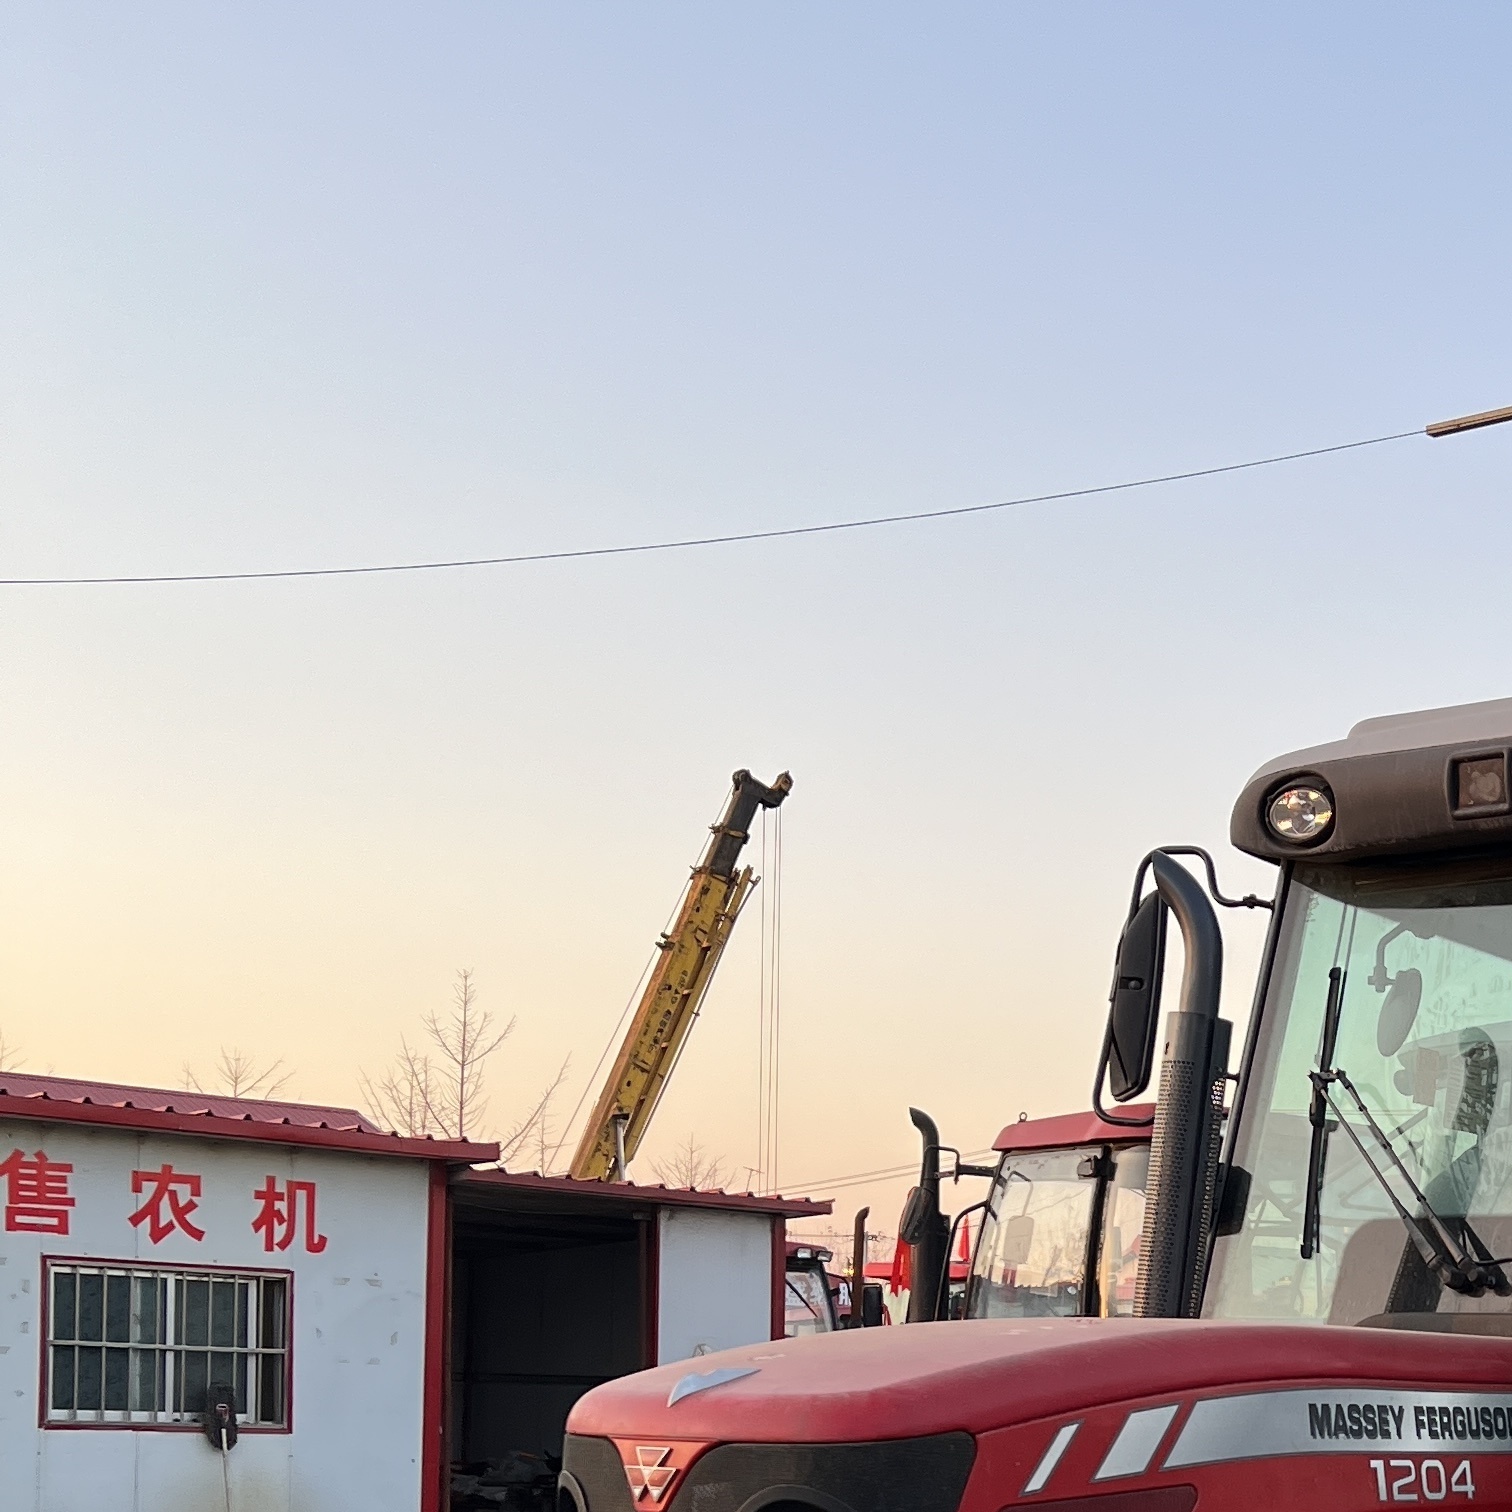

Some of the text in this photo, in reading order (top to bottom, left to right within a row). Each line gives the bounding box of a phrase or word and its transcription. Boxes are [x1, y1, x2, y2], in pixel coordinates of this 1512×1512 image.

[0, 1149, 328, 1254] 售农机
[1308, 1403, 1405, 1440] MASSEY
[1370, 1459, 1475, 1501] 1204
